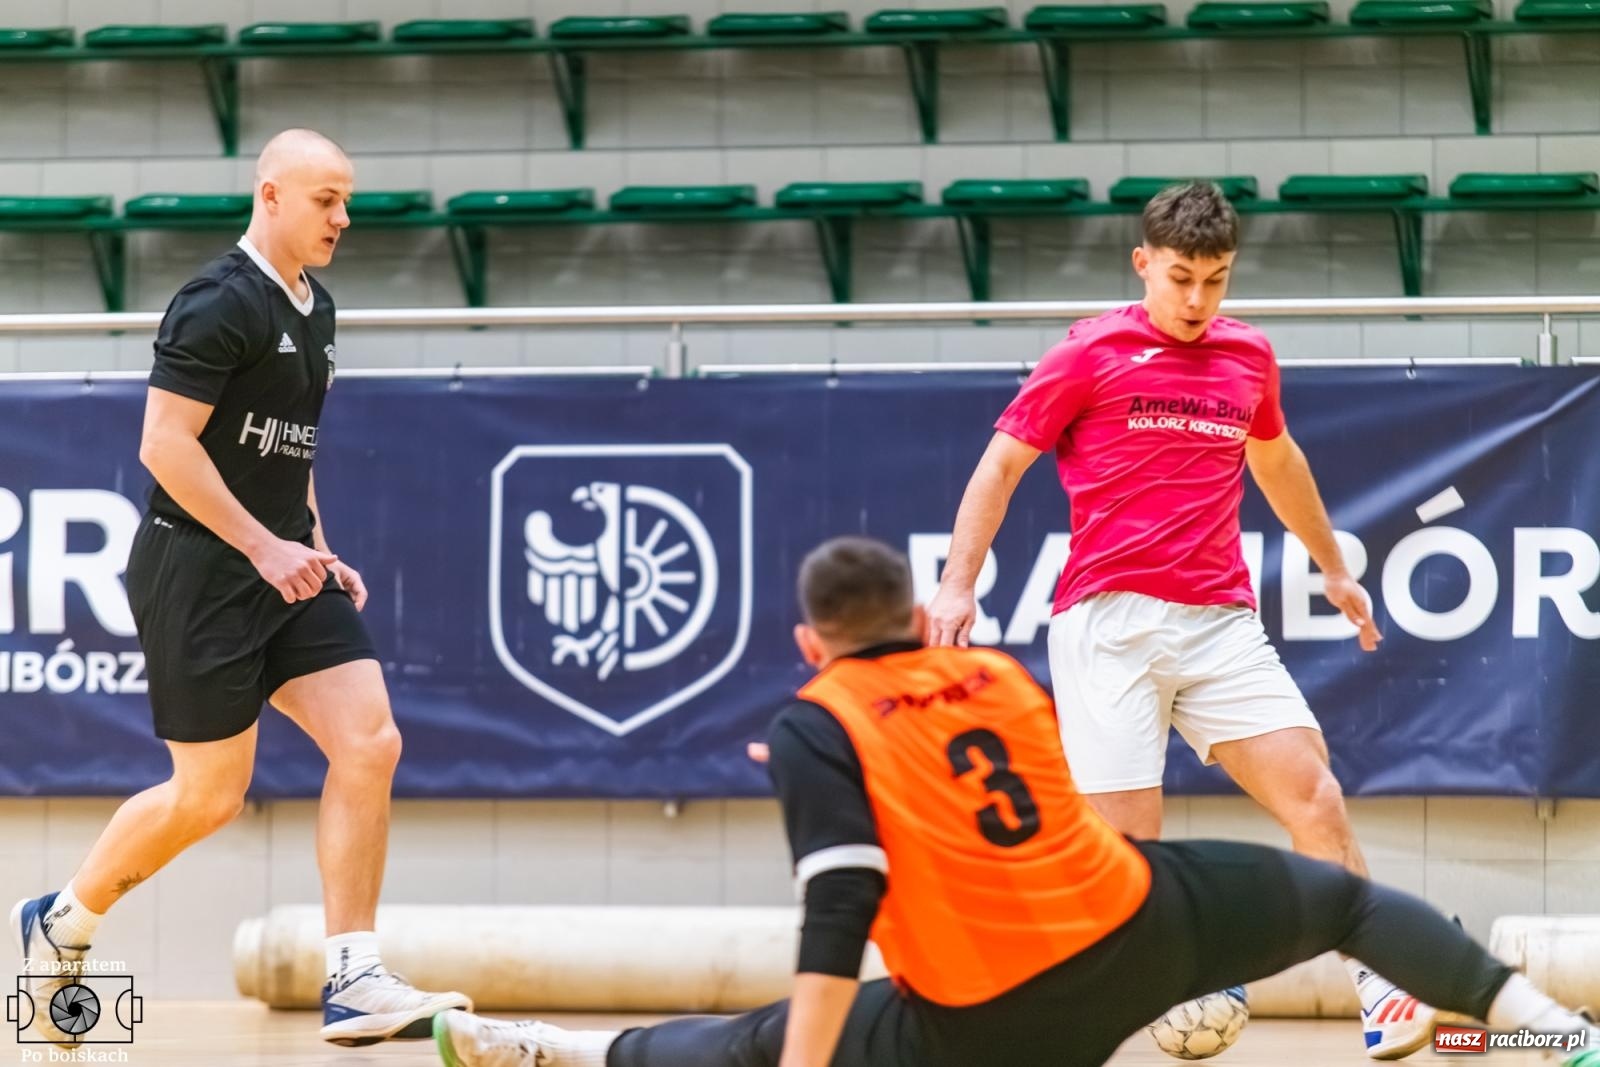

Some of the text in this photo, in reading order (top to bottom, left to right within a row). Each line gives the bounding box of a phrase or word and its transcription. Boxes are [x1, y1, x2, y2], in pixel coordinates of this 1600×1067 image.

[1127, 416, 1187, 431] KOLORZ
[908, 485, 1600, 645] RABÓR
[947, 728, 1041, 848] 3
